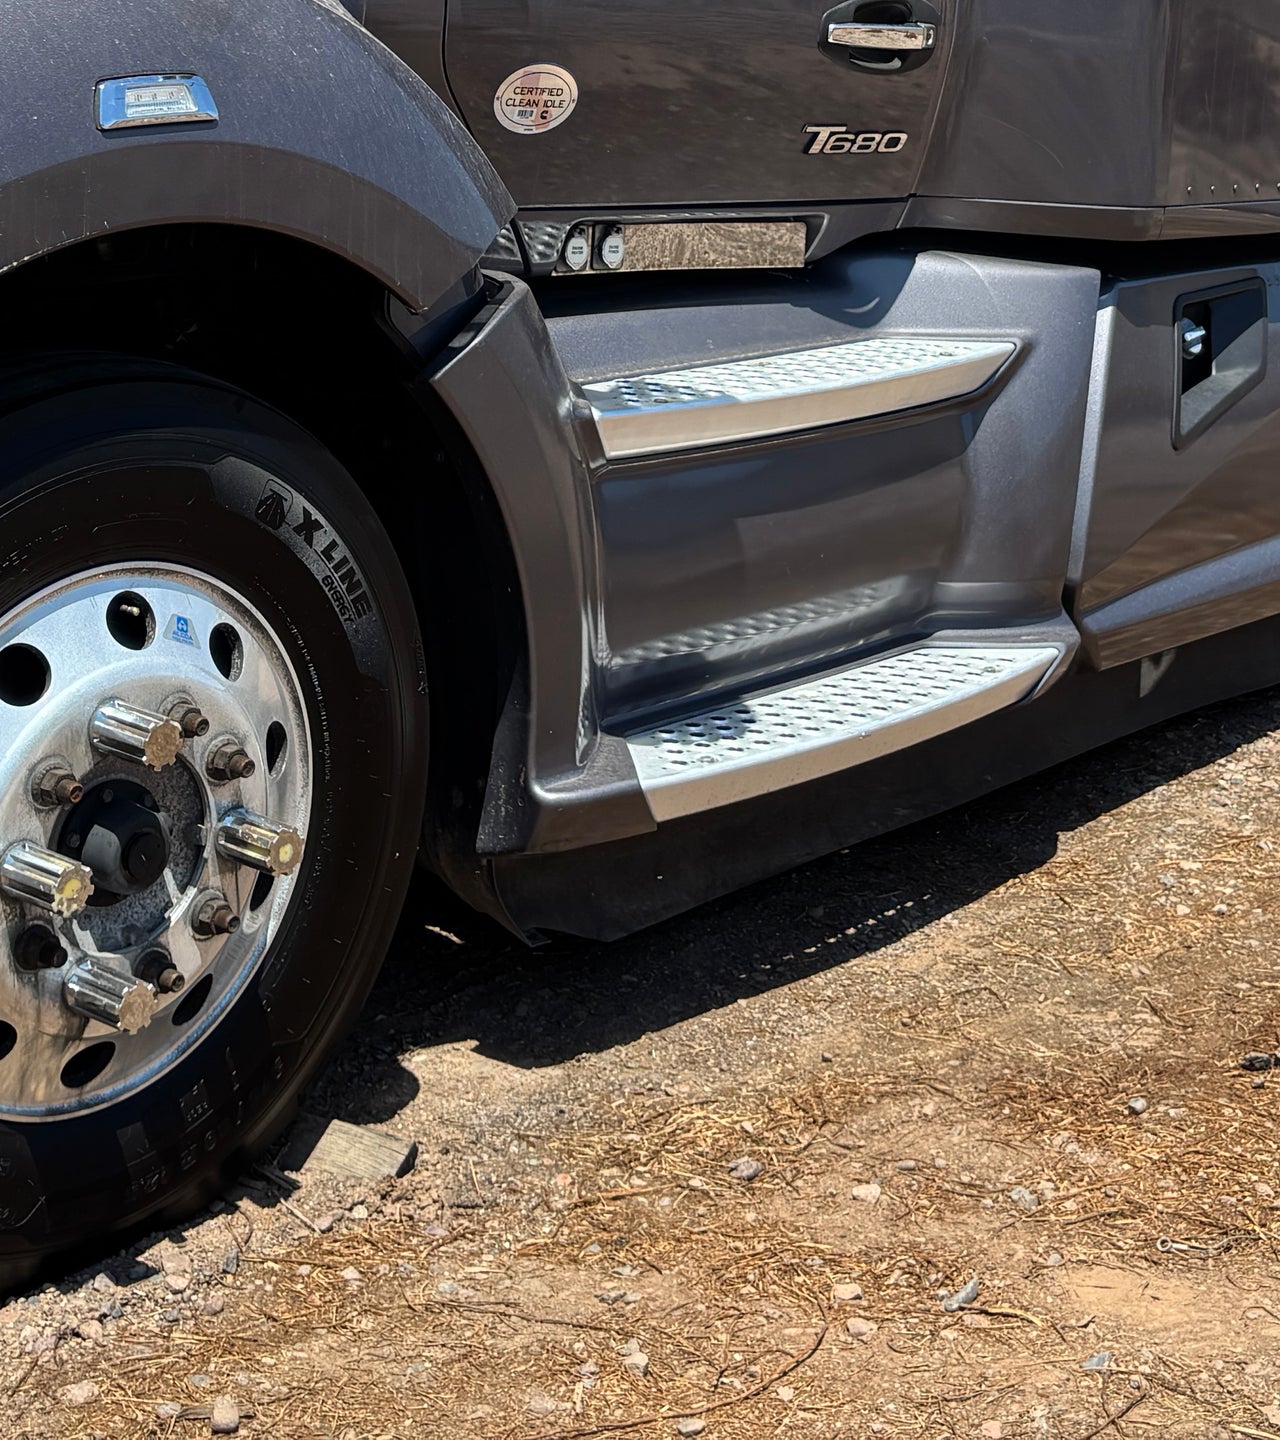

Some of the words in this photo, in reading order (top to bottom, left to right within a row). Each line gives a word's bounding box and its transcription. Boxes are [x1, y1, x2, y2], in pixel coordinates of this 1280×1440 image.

[505, 98, 540, 108] CLEAN
[542, 99, 566, 109] IDLE
[513, 86, 564, 97] CERTIFIED
[804, 125, 909, 155] T680
[292, 506, 326, 549] X
[320, 538, 373, 620] LINE
[321, 574, 356, 625] ENERGY
